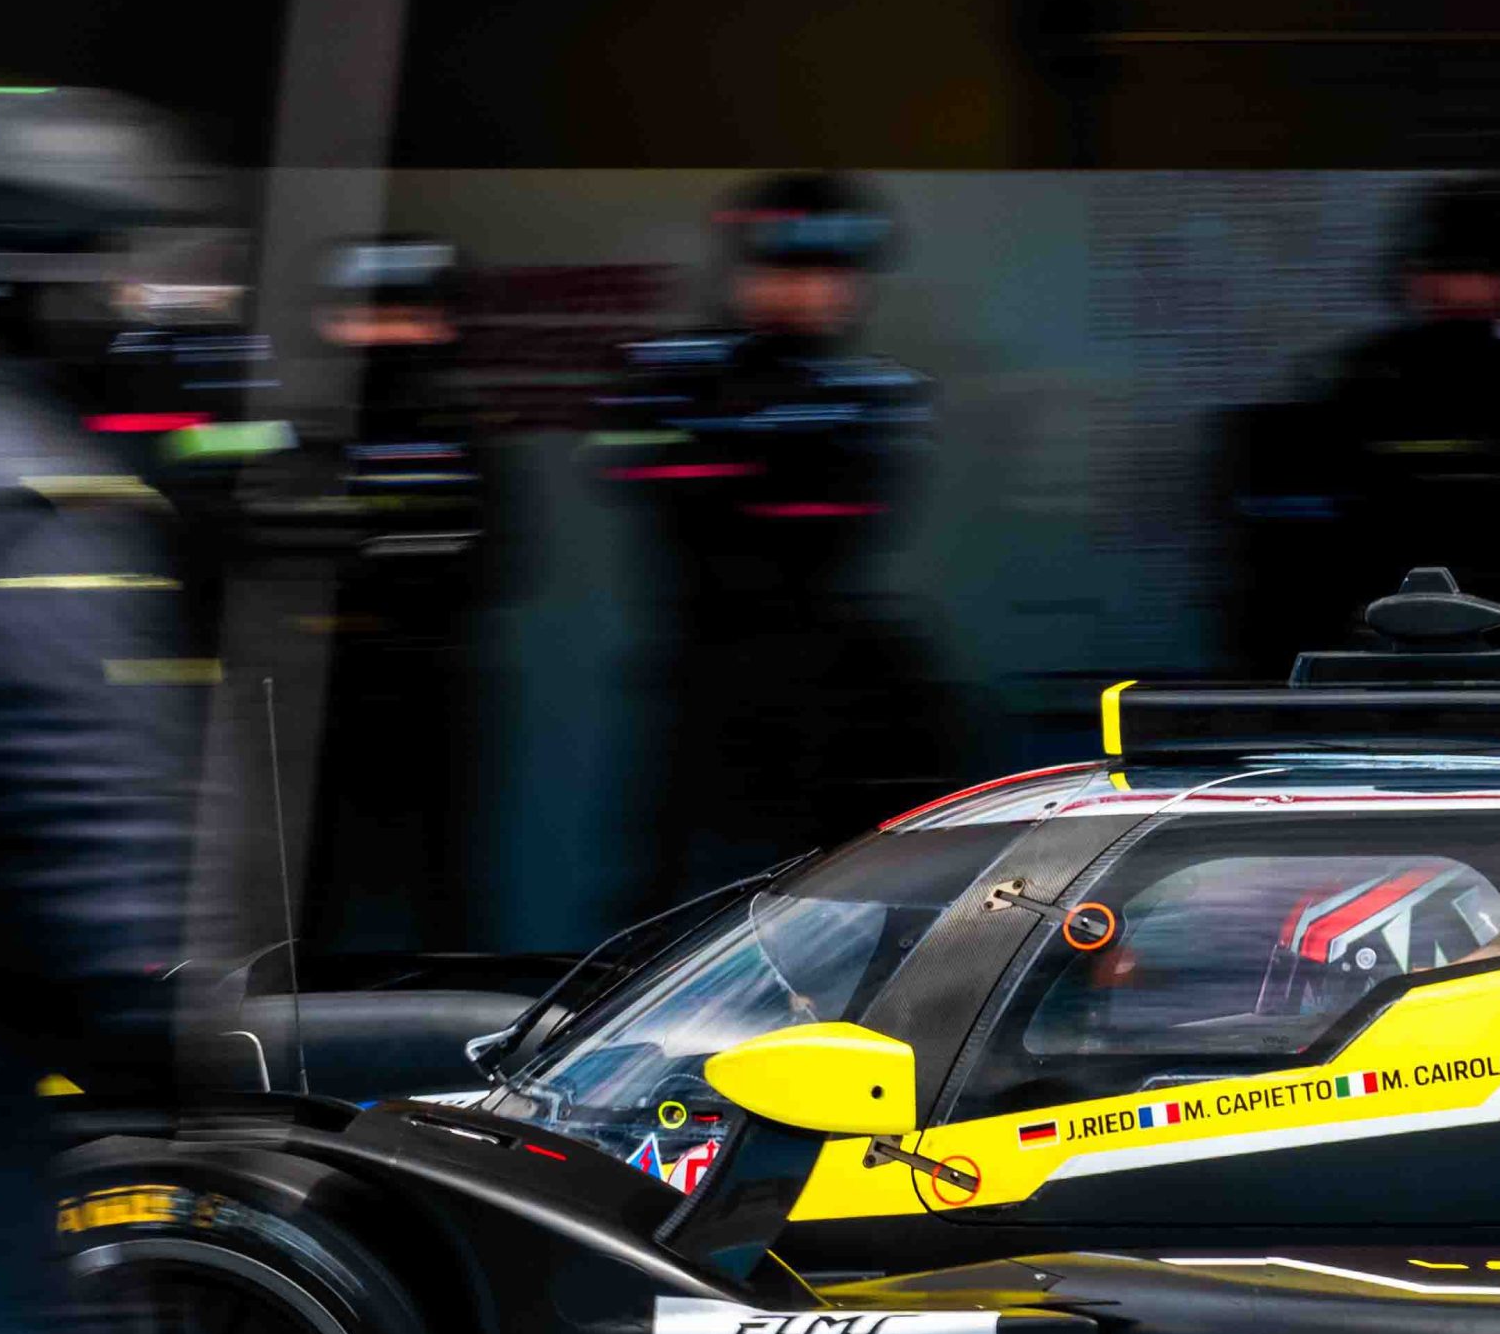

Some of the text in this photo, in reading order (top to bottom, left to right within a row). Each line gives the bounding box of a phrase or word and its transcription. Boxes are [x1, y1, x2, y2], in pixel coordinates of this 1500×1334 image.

[1382, 1069, 1408, 1090] M.
[1184, 1080, 1332, 1119] M. CAPIETTO
[1066, 1110, 1135, 1141] J.RIED
